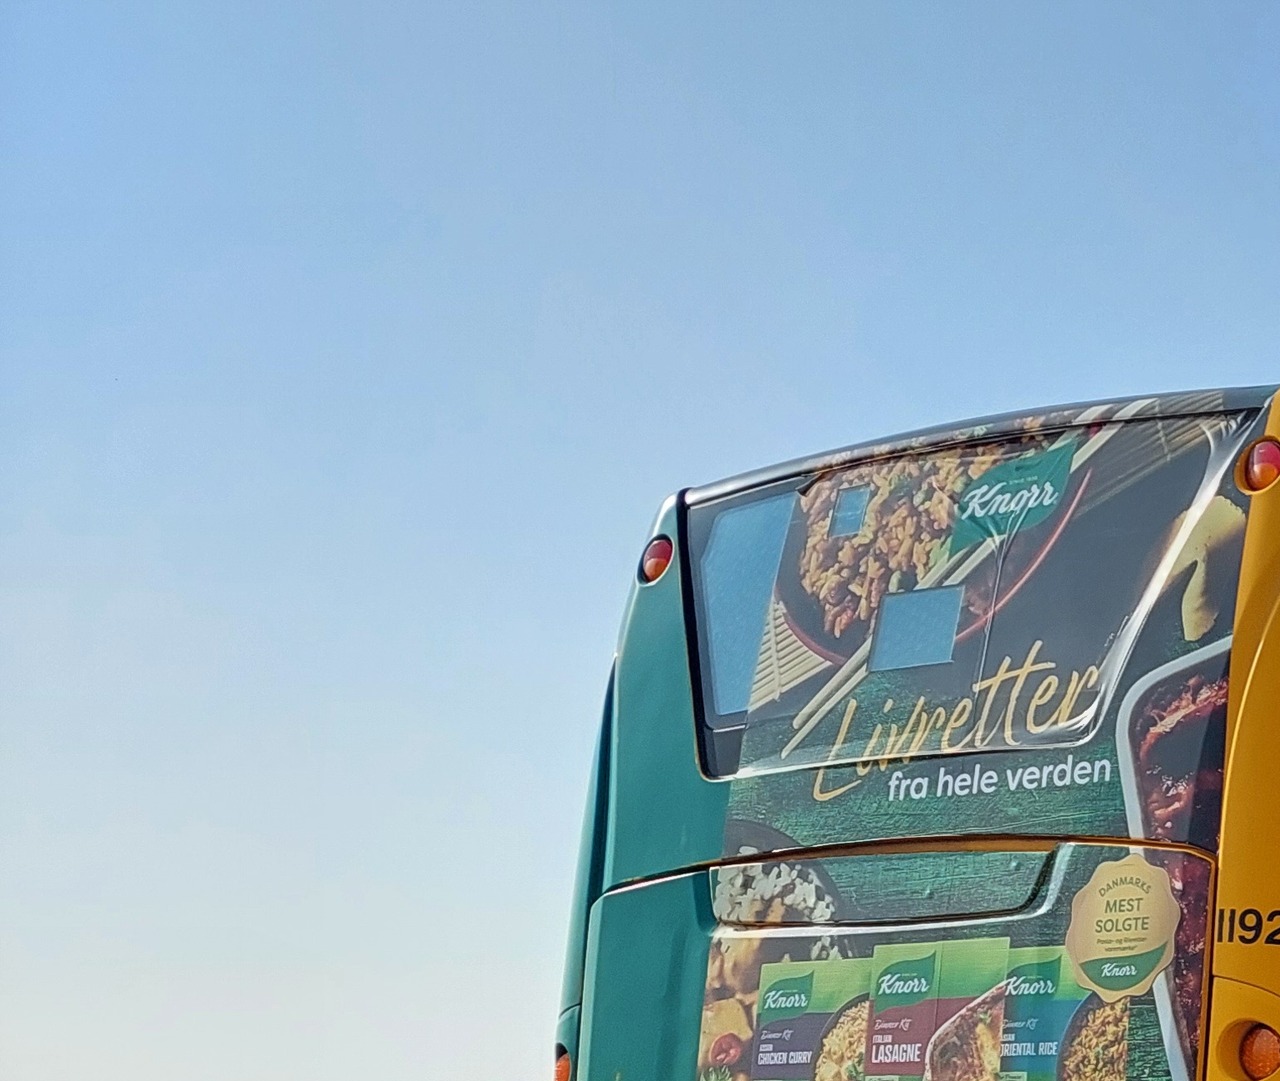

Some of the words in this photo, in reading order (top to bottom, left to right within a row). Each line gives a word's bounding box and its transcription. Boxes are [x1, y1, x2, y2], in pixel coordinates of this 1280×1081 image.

[962, 481, 1059, 520] Knorr
[887, 772, 928, 801] fra
[936, 762, 999, 797] hele
[1006, 755, 1111, 791] verden
[1098, 876, 1152, 898] DANMARKS
[1104, 898, 1144, 913] MEST
[1095, 916, 1150, 933] SOLGTE
[1101, 962, 1138, 978] Knorr
[878, 974, 930, 995] Knorr
[1004, 976, 1056, 996] Knorr
[764, 990, 808, 1009] Knorr
[758, 1052, 788, 1065] CHICKEN
[788, 1051, 812, 1064] CURRY
[871, 1043, 922, 1063] LASAGNE
[1038, 1042, 1058, 1056] RICE
